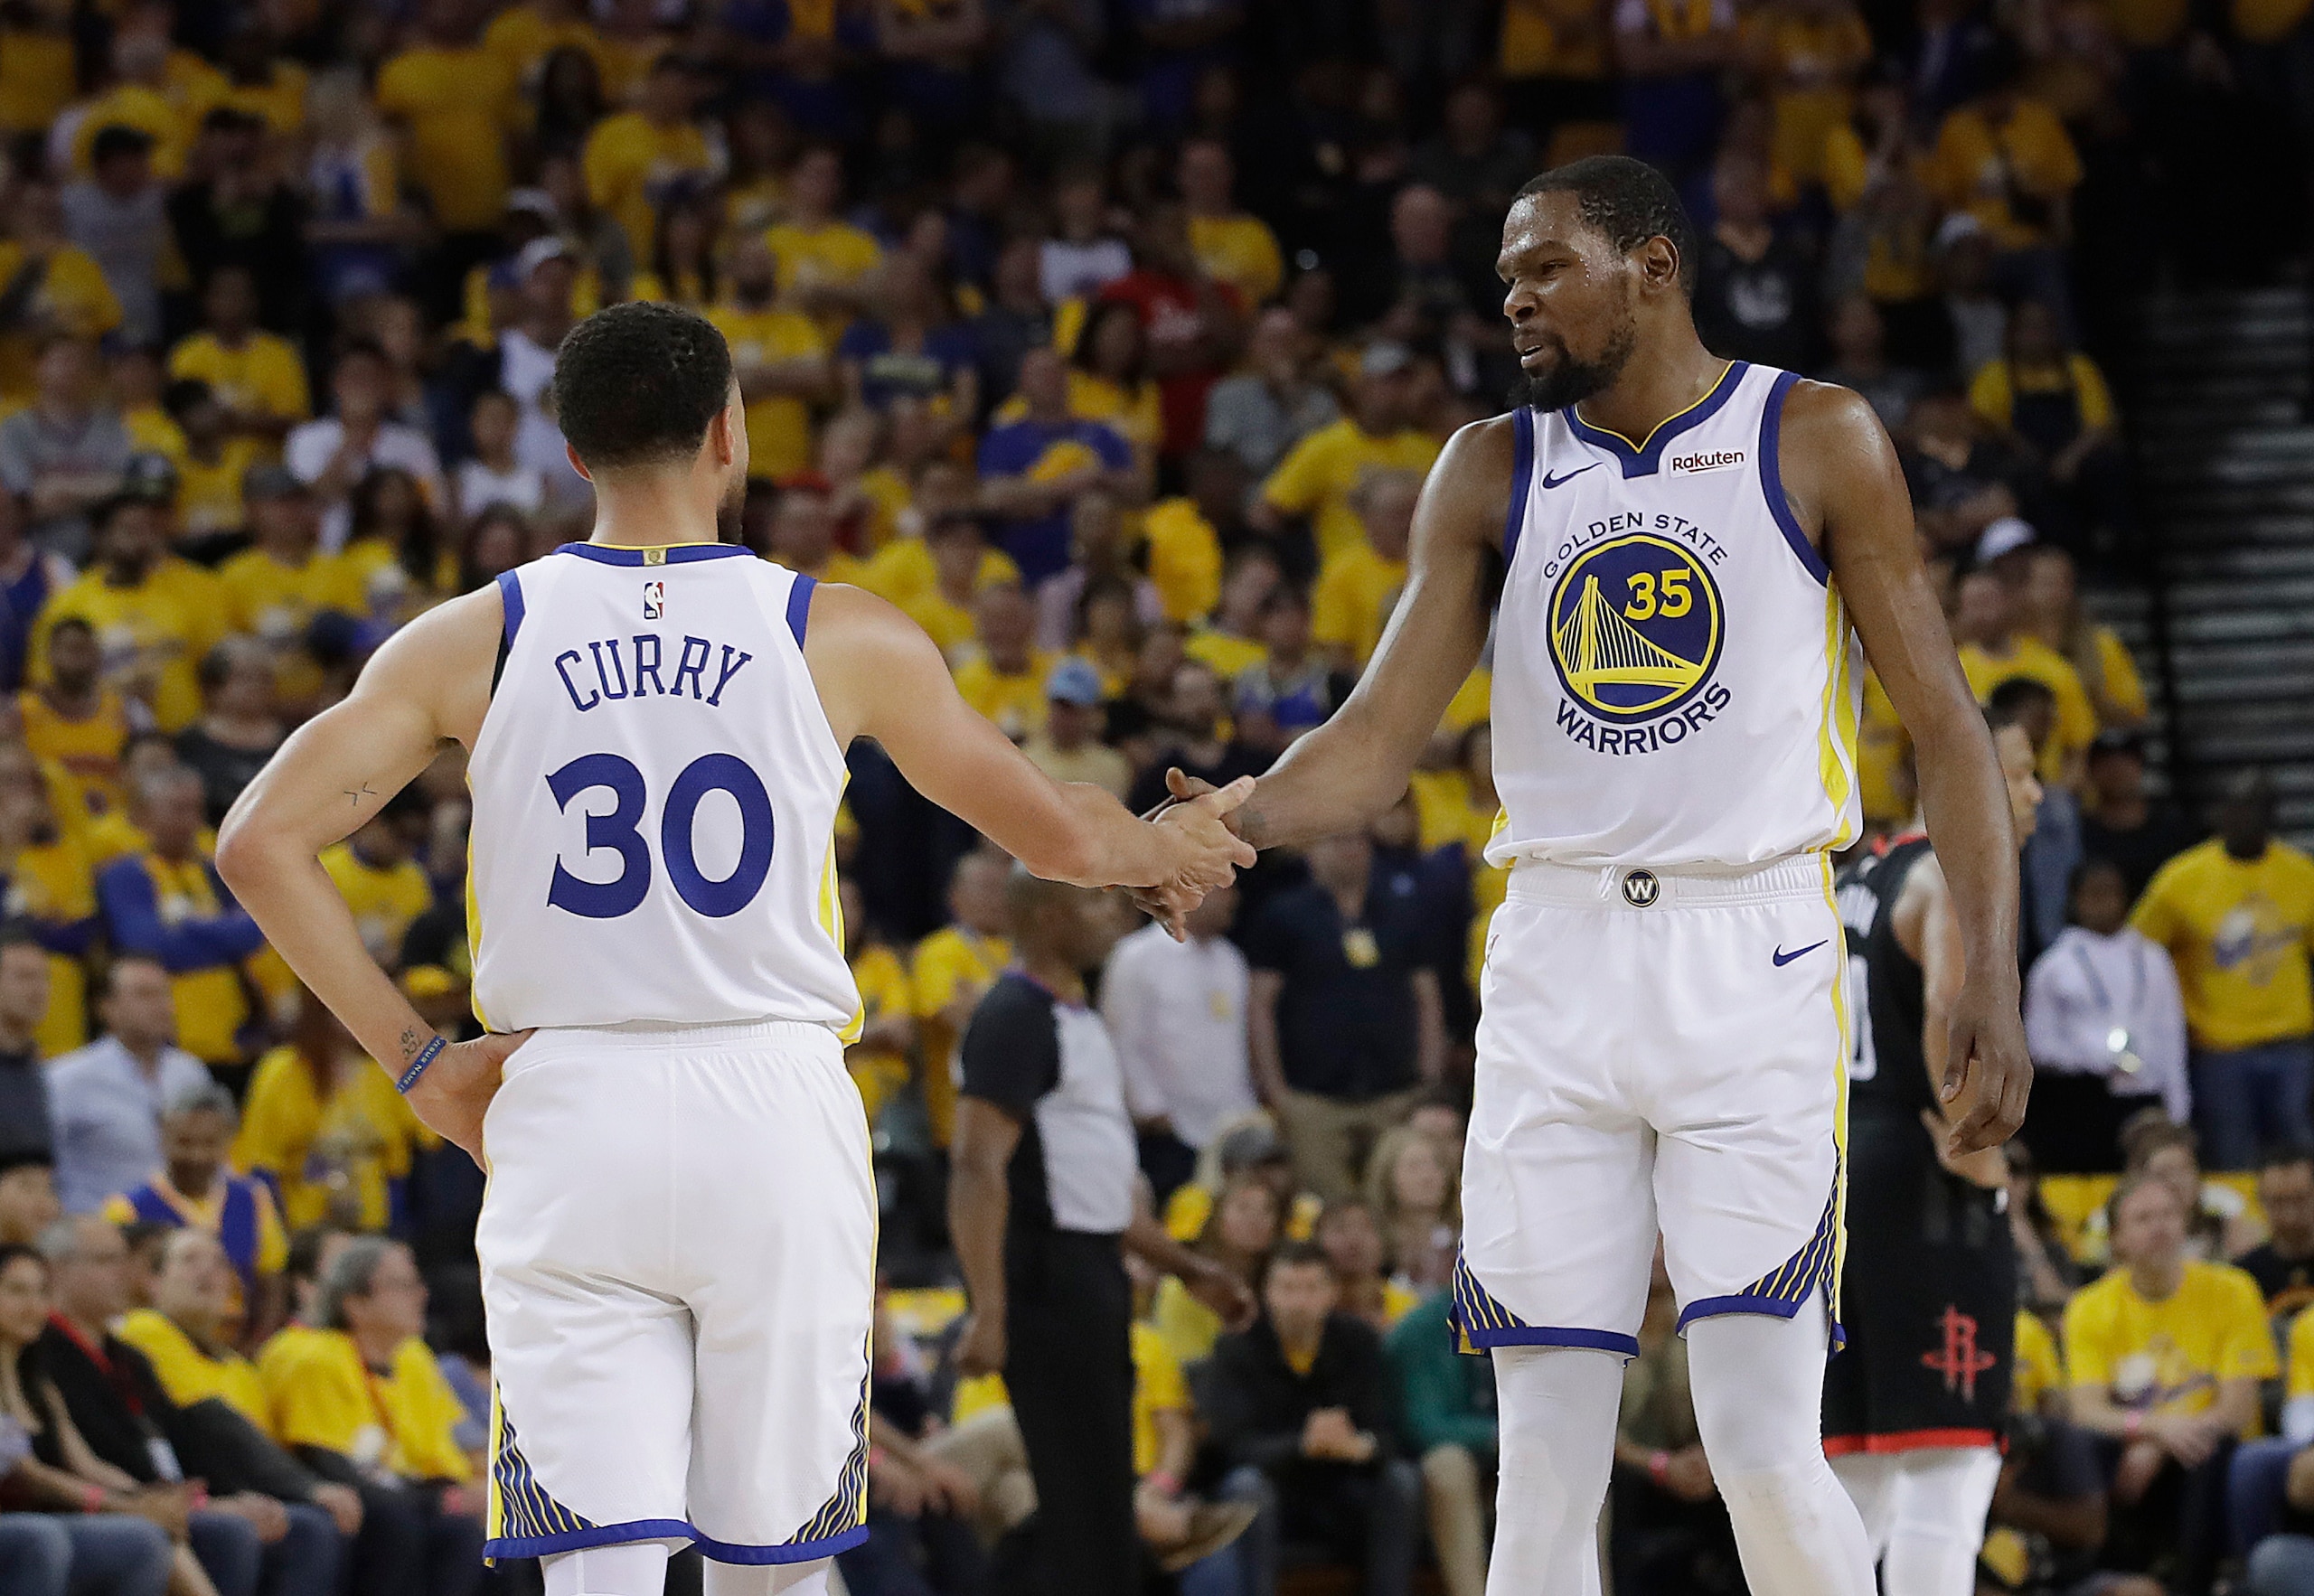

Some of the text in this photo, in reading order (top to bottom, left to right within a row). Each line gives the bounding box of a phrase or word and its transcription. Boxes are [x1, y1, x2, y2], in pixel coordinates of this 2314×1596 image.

[1672, 451, 1745, 472] Rakuten
[1544, 512, 1728, 578] GOLDEN STATE
[1623, 567, 1693, 621] 35
[555, 634, 753, 711] CURRY
[1556, 681, 1731, 756] WARRIORS
[545, 753, 775, 918] 30
